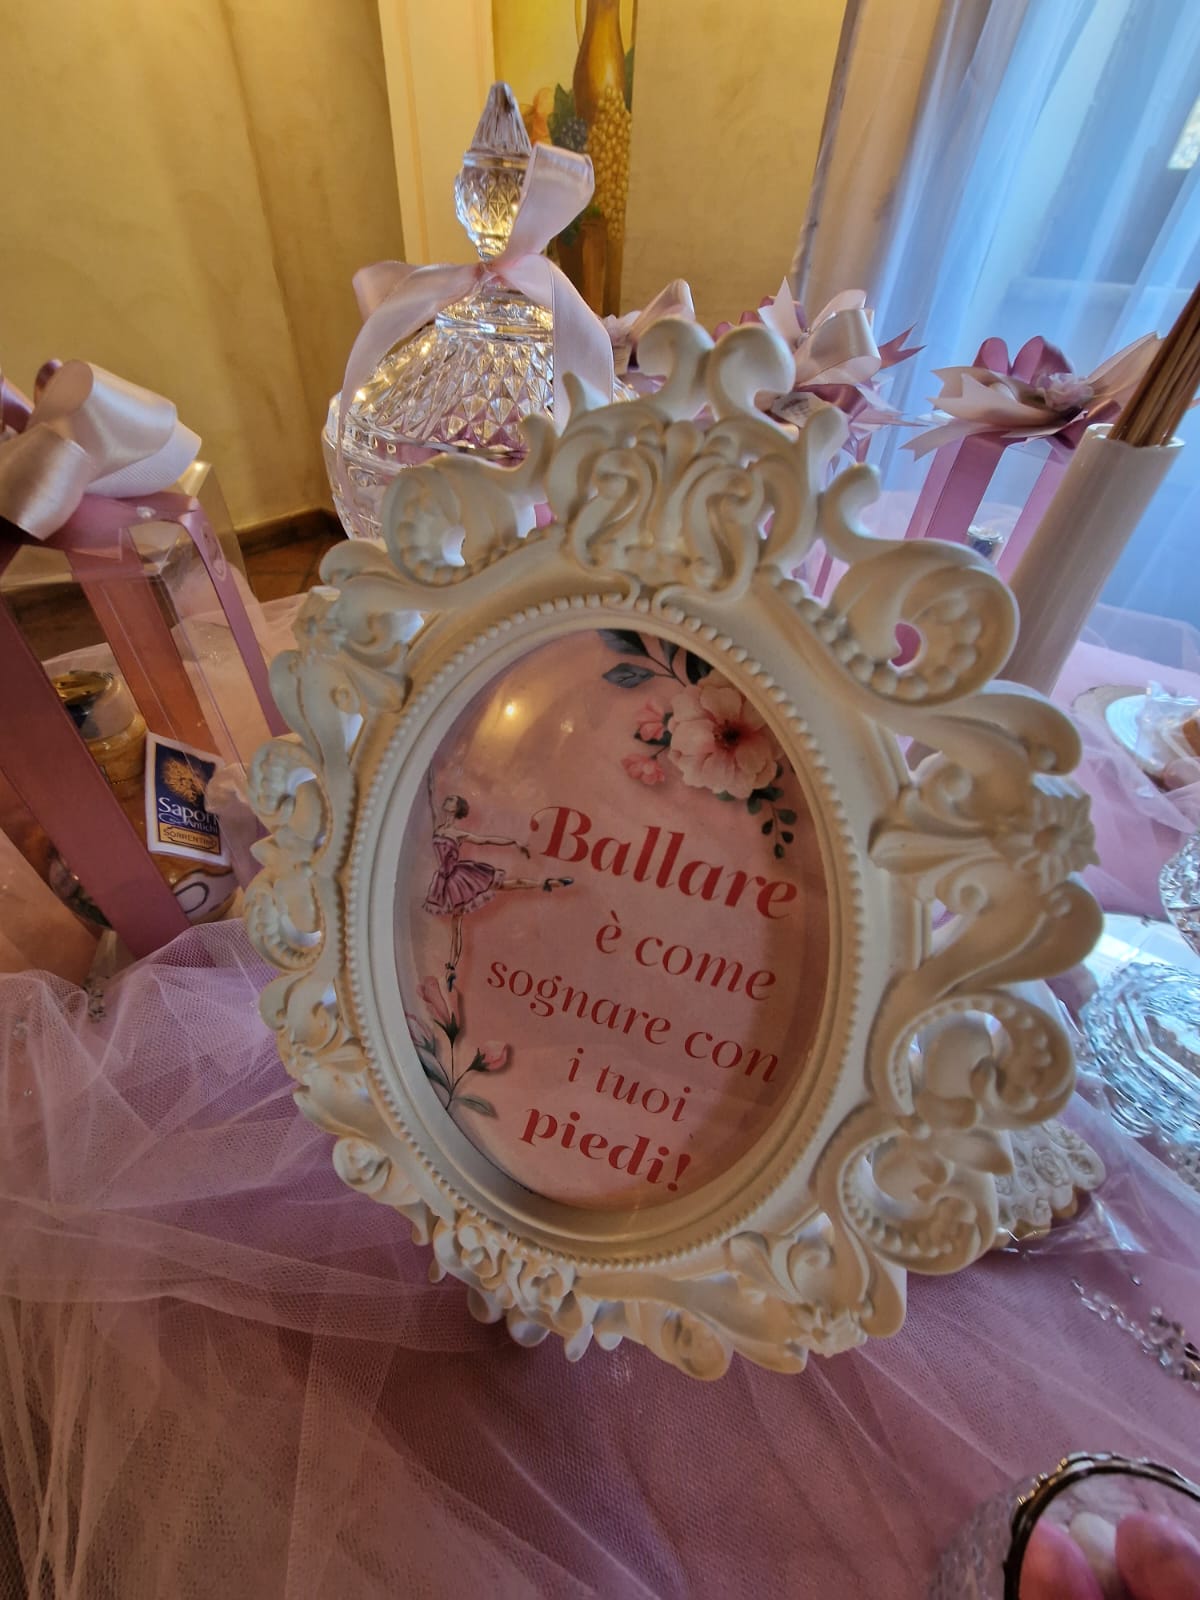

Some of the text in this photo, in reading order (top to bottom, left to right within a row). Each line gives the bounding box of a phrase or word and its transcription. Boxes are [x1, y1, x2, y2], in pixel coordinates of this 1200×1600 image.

[530, 806, 798, 920] Ballare
[595, 910, 777, 1001] è come
[487, 961, 780, 1083] sognare con
[568, 1048, 692, 1122] i tuoi
[518, 1107, 692, 1192] piedi!
